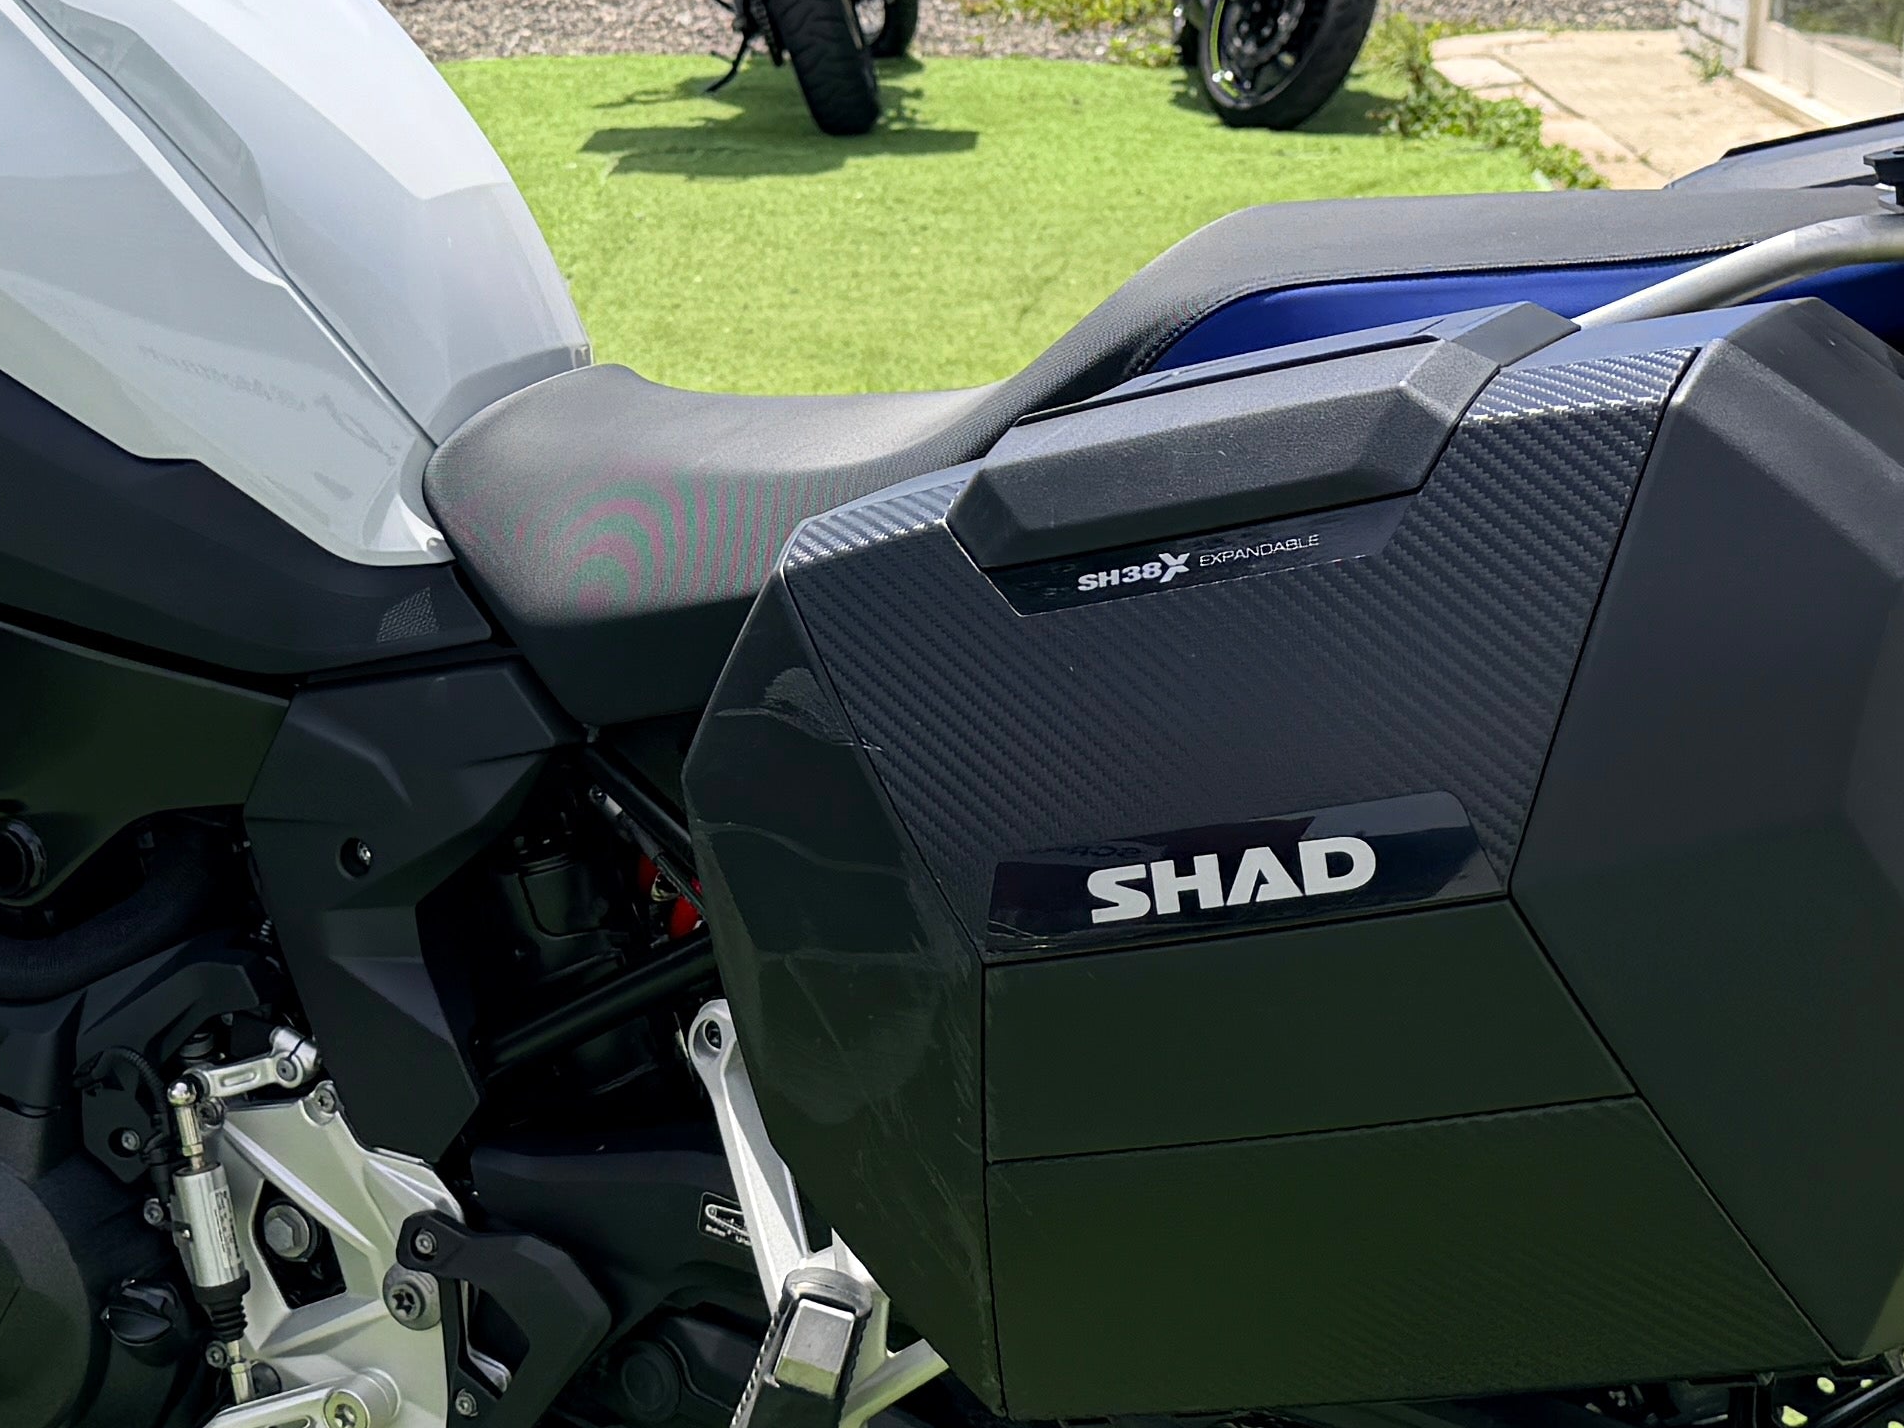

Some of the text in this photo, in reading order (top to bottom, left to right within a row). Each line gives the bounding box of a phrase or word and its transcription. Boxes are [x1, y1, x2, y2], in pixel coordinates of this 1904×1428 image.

[1077, 533, 1321, 592] SH38X EXPANDABLE
[1089, 835, 1377, 925] SHAD
